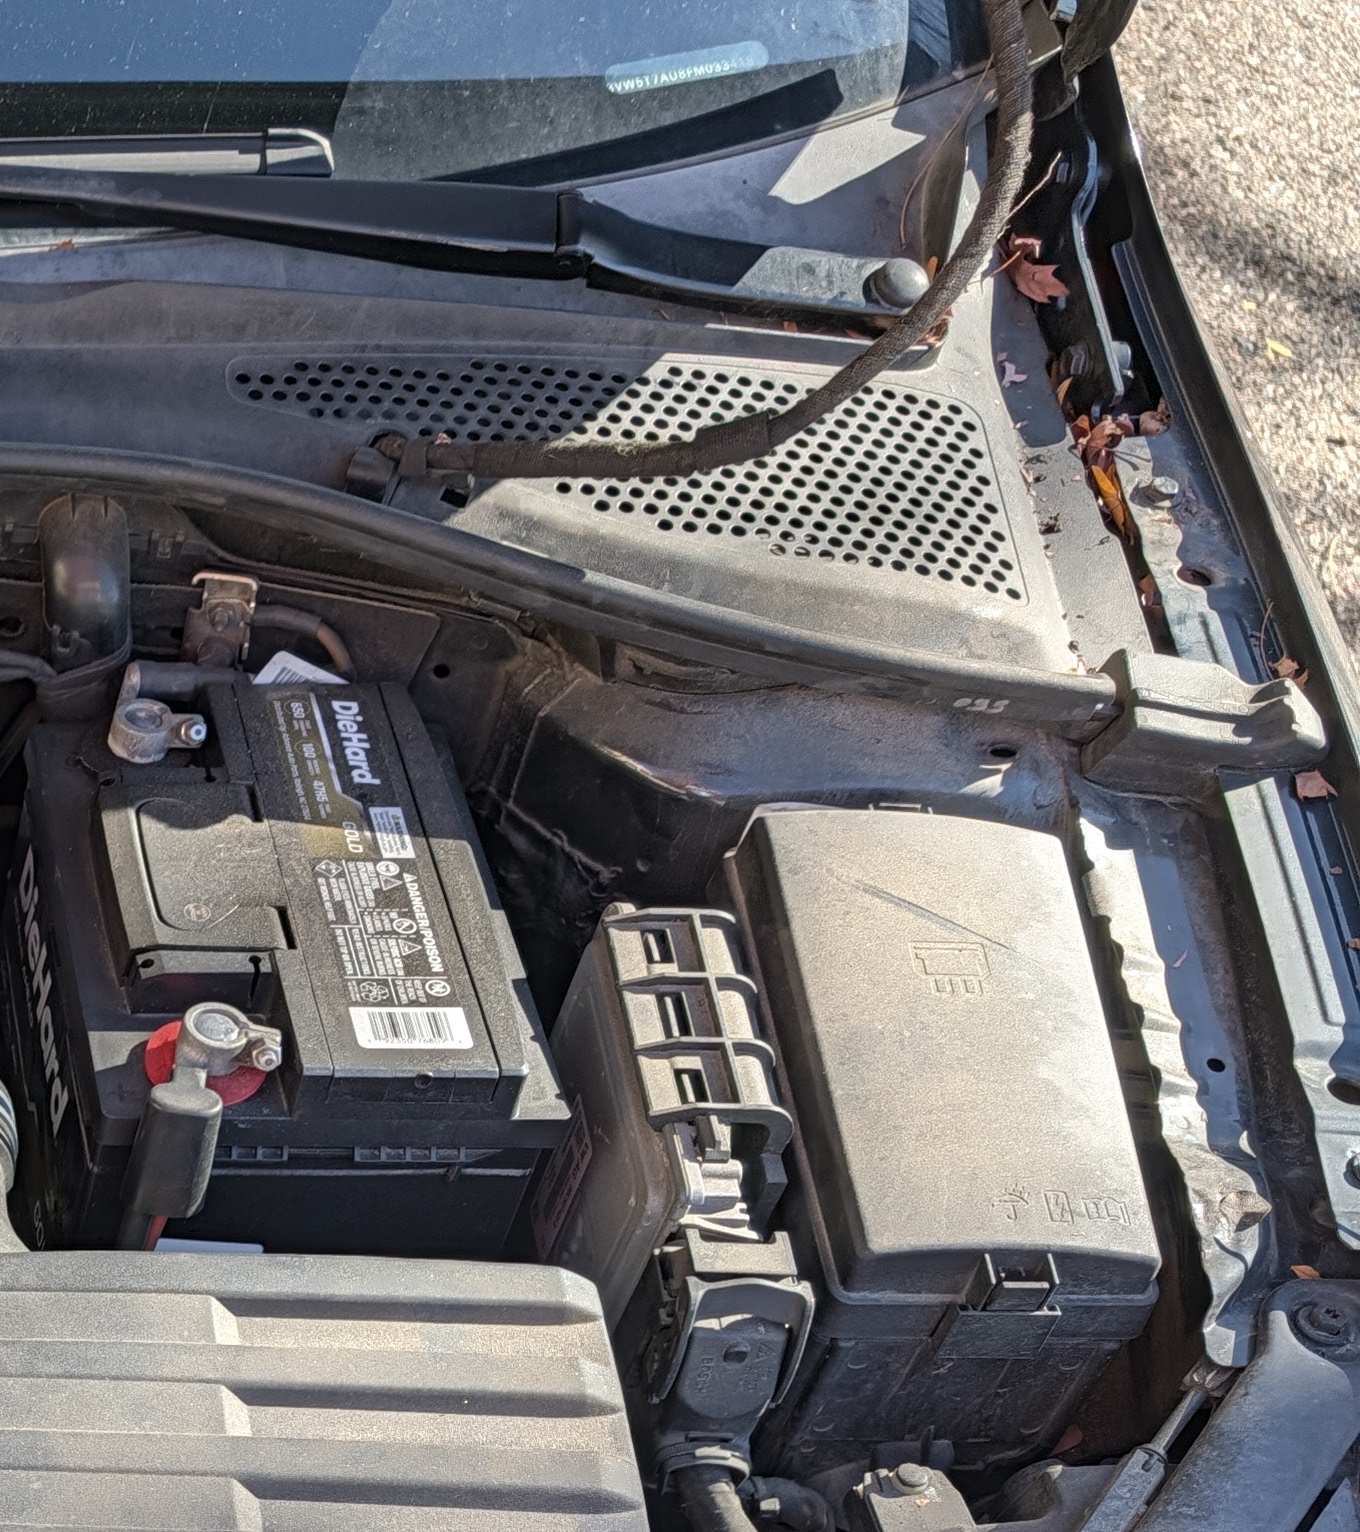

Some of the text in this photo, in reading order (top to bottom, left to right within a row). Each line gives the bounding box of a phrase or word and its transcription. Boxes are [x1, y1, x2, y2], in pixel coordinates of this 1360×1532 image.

[291, 702, 305, 719] 650
[302, 743, 316, 759] 100
[331, 700, 381, 785] DieHard
[342, 820, 363, 853] GOLD
[405, 882, 444, 973] DANGER/POISON
[19, 843, 69, 1138] DieHard
